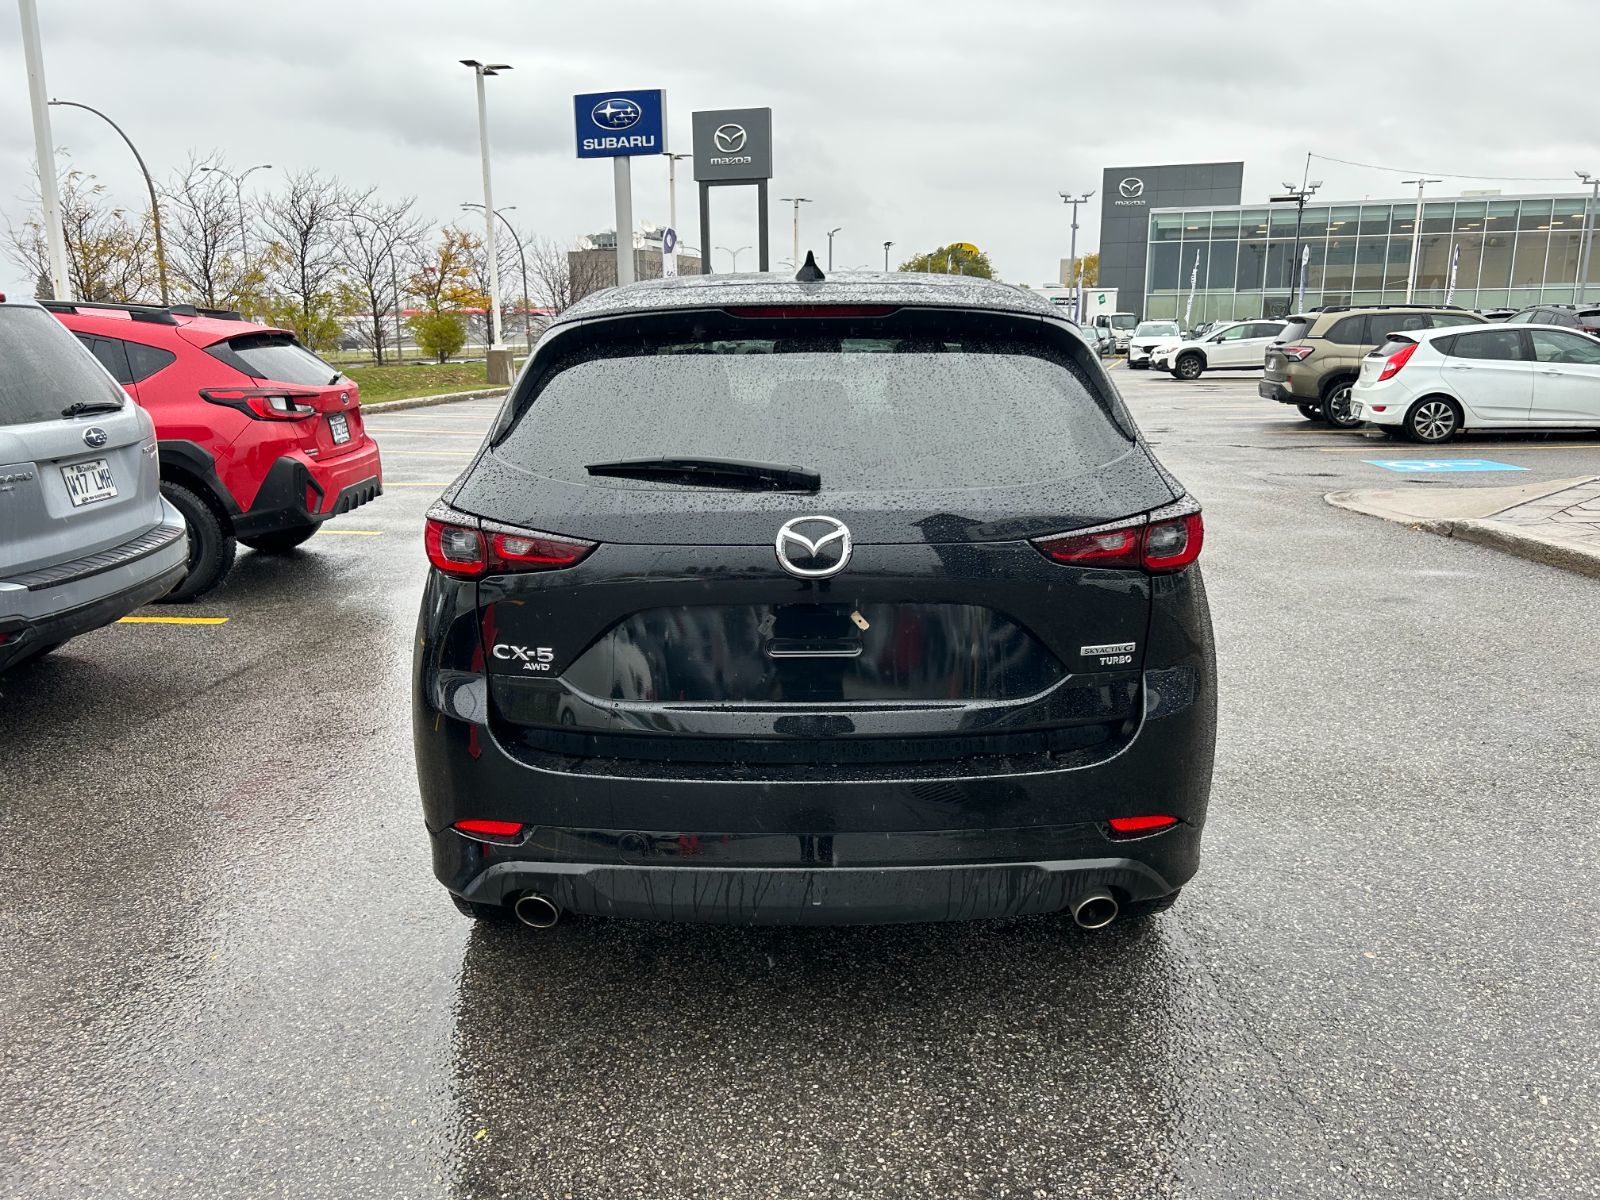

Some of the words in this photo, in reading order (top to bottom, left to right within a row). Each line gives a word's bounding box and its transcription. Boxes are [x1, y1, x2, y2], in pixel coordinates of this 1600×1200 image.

[583, 135, 655, 150] SUBARU
[710, 155, 752, 165] mazda
[67, 473, 89, 496] W17
[92, 468, 114, 490] LMH
[492, 643, 554, 663] CX-5
[522, 662, 551, 671] AWD
[1099, 655, 1132, 666] TURBO
